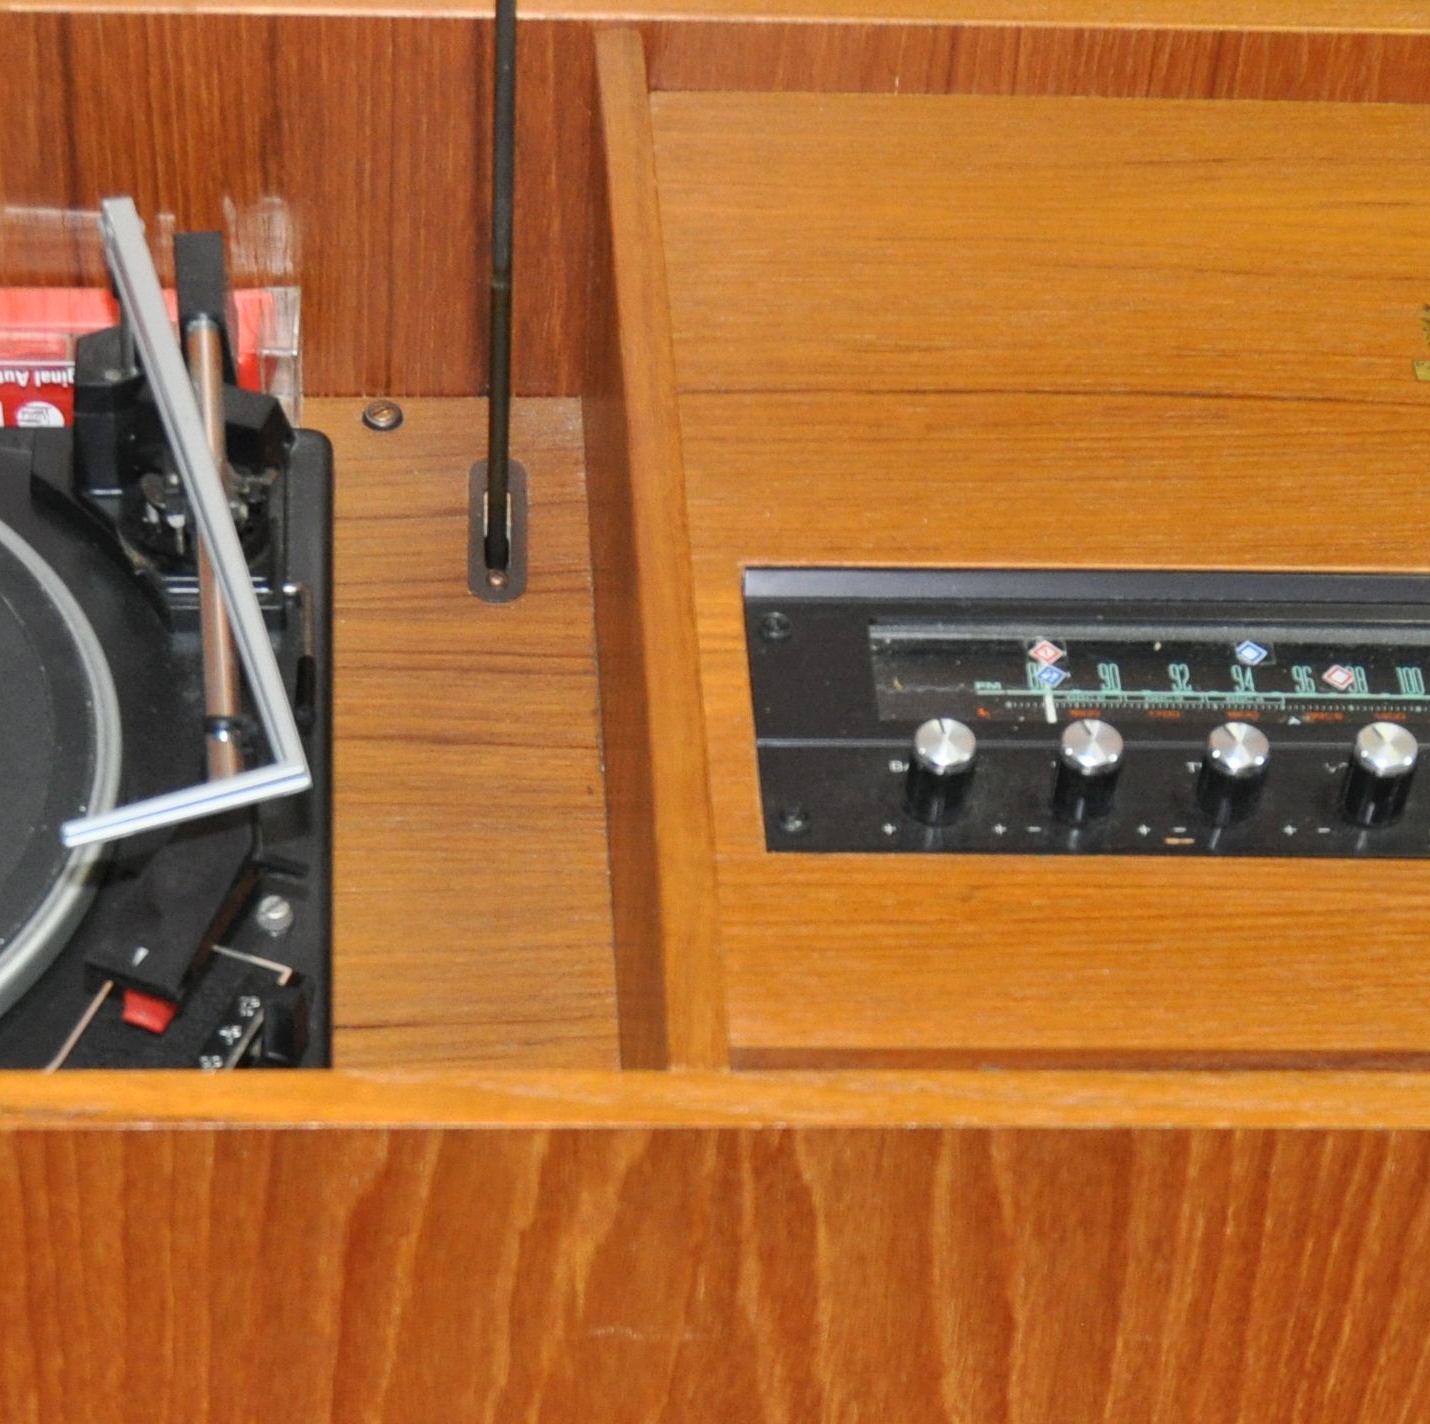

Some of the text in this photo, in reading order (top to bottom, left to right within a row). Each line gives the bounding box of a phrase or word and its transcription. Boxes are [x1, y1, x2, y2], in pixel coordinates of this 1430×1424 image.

[1097, 663, 1122, 690] 90
[1168, 663, 1193, 691] 92
[1231, 664, 1256, 691] 94
[1291, 665, 1316, 692] 96
[1395, 667, 1425, 694] 100
